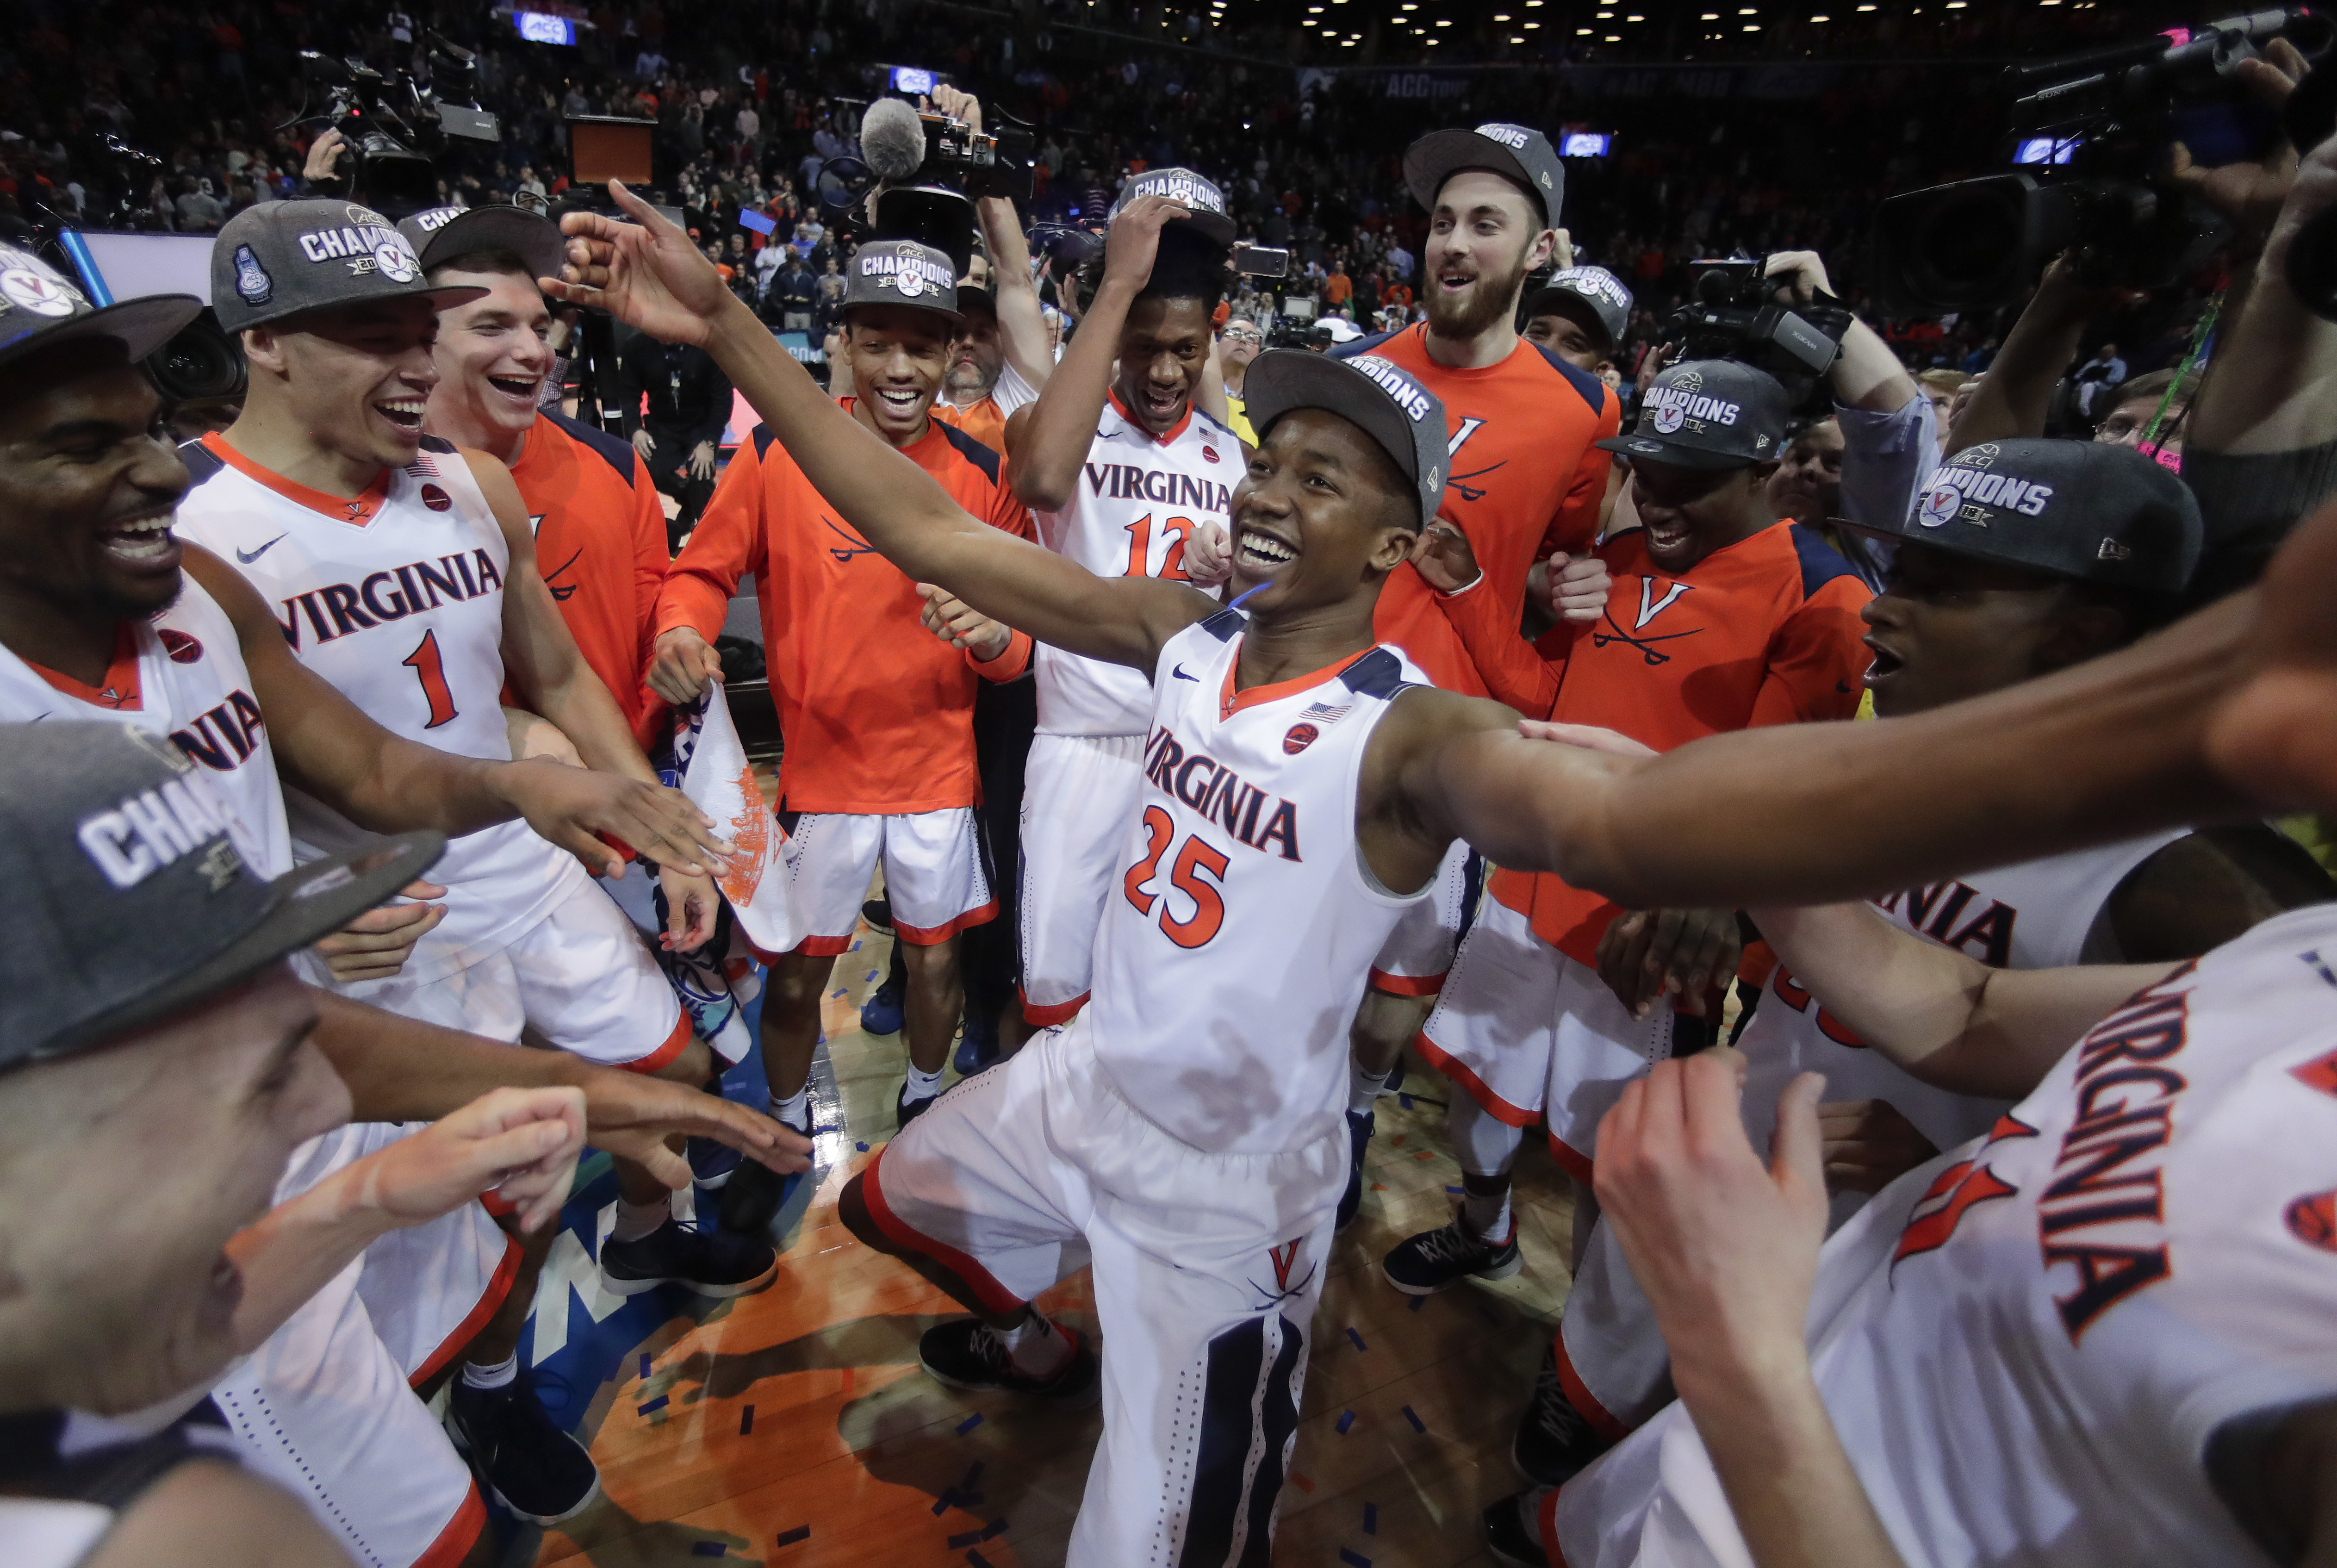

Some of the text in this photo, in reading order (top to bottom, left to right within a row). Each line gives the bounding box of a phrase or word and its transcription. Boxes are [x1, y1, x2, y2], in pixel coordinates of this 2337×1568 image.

[1135, 178, 1222, 212] CHAMPIONS
[862, 256, 952, 290] CHAMPIONS
[1085, 463, 1231, 516] VIRGINIA
[1123, 513, 1195, 582] 12
[276, 548, 503, 654] VIRGINIA
[402, 628, 460, 729] 1
[1144, 716, 1303, 863] VIRGINIA
[1124, 804, 1231, 949] 25
[2036, 956, 2200, 1350] VIRGINIA
